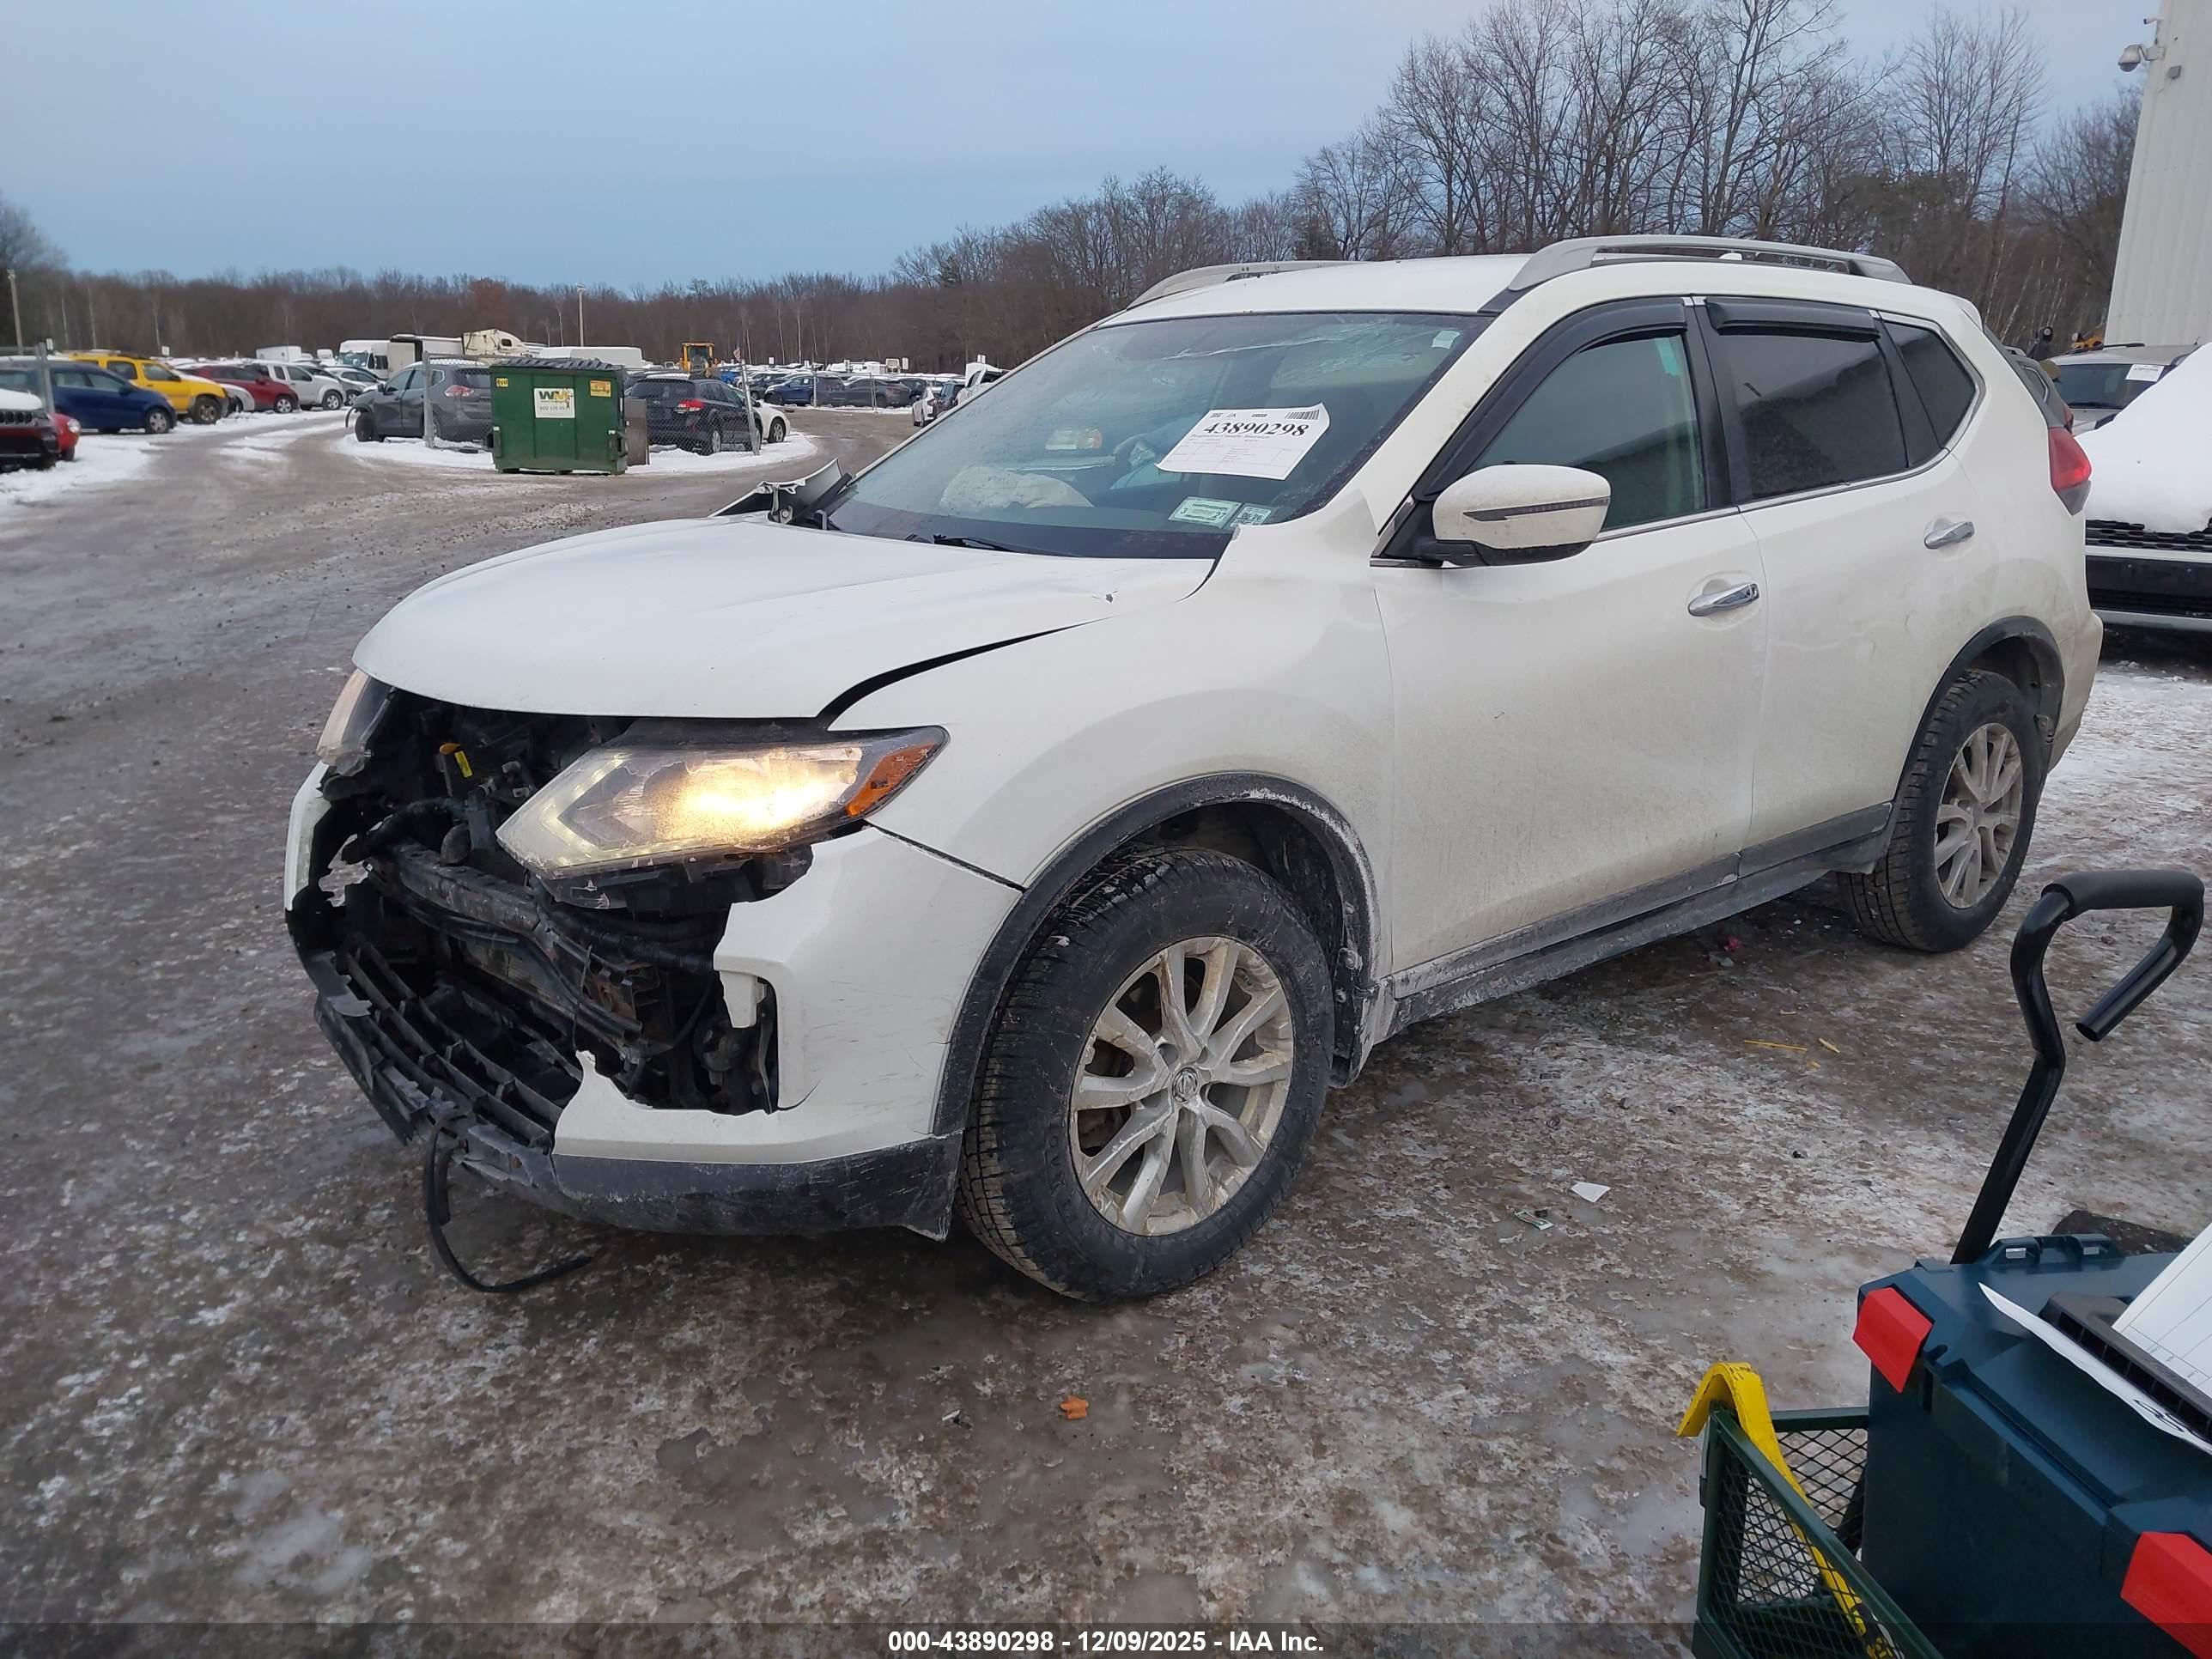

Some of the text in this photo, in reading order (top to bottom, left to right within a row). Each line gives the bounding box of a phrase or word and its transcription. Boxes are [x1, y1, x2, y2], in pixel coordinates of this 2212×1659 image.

[538, 391, 568, 399] WM
[1203, 422, 1310, 436] 43890298
[1212, 511, 1227, 520] 27
